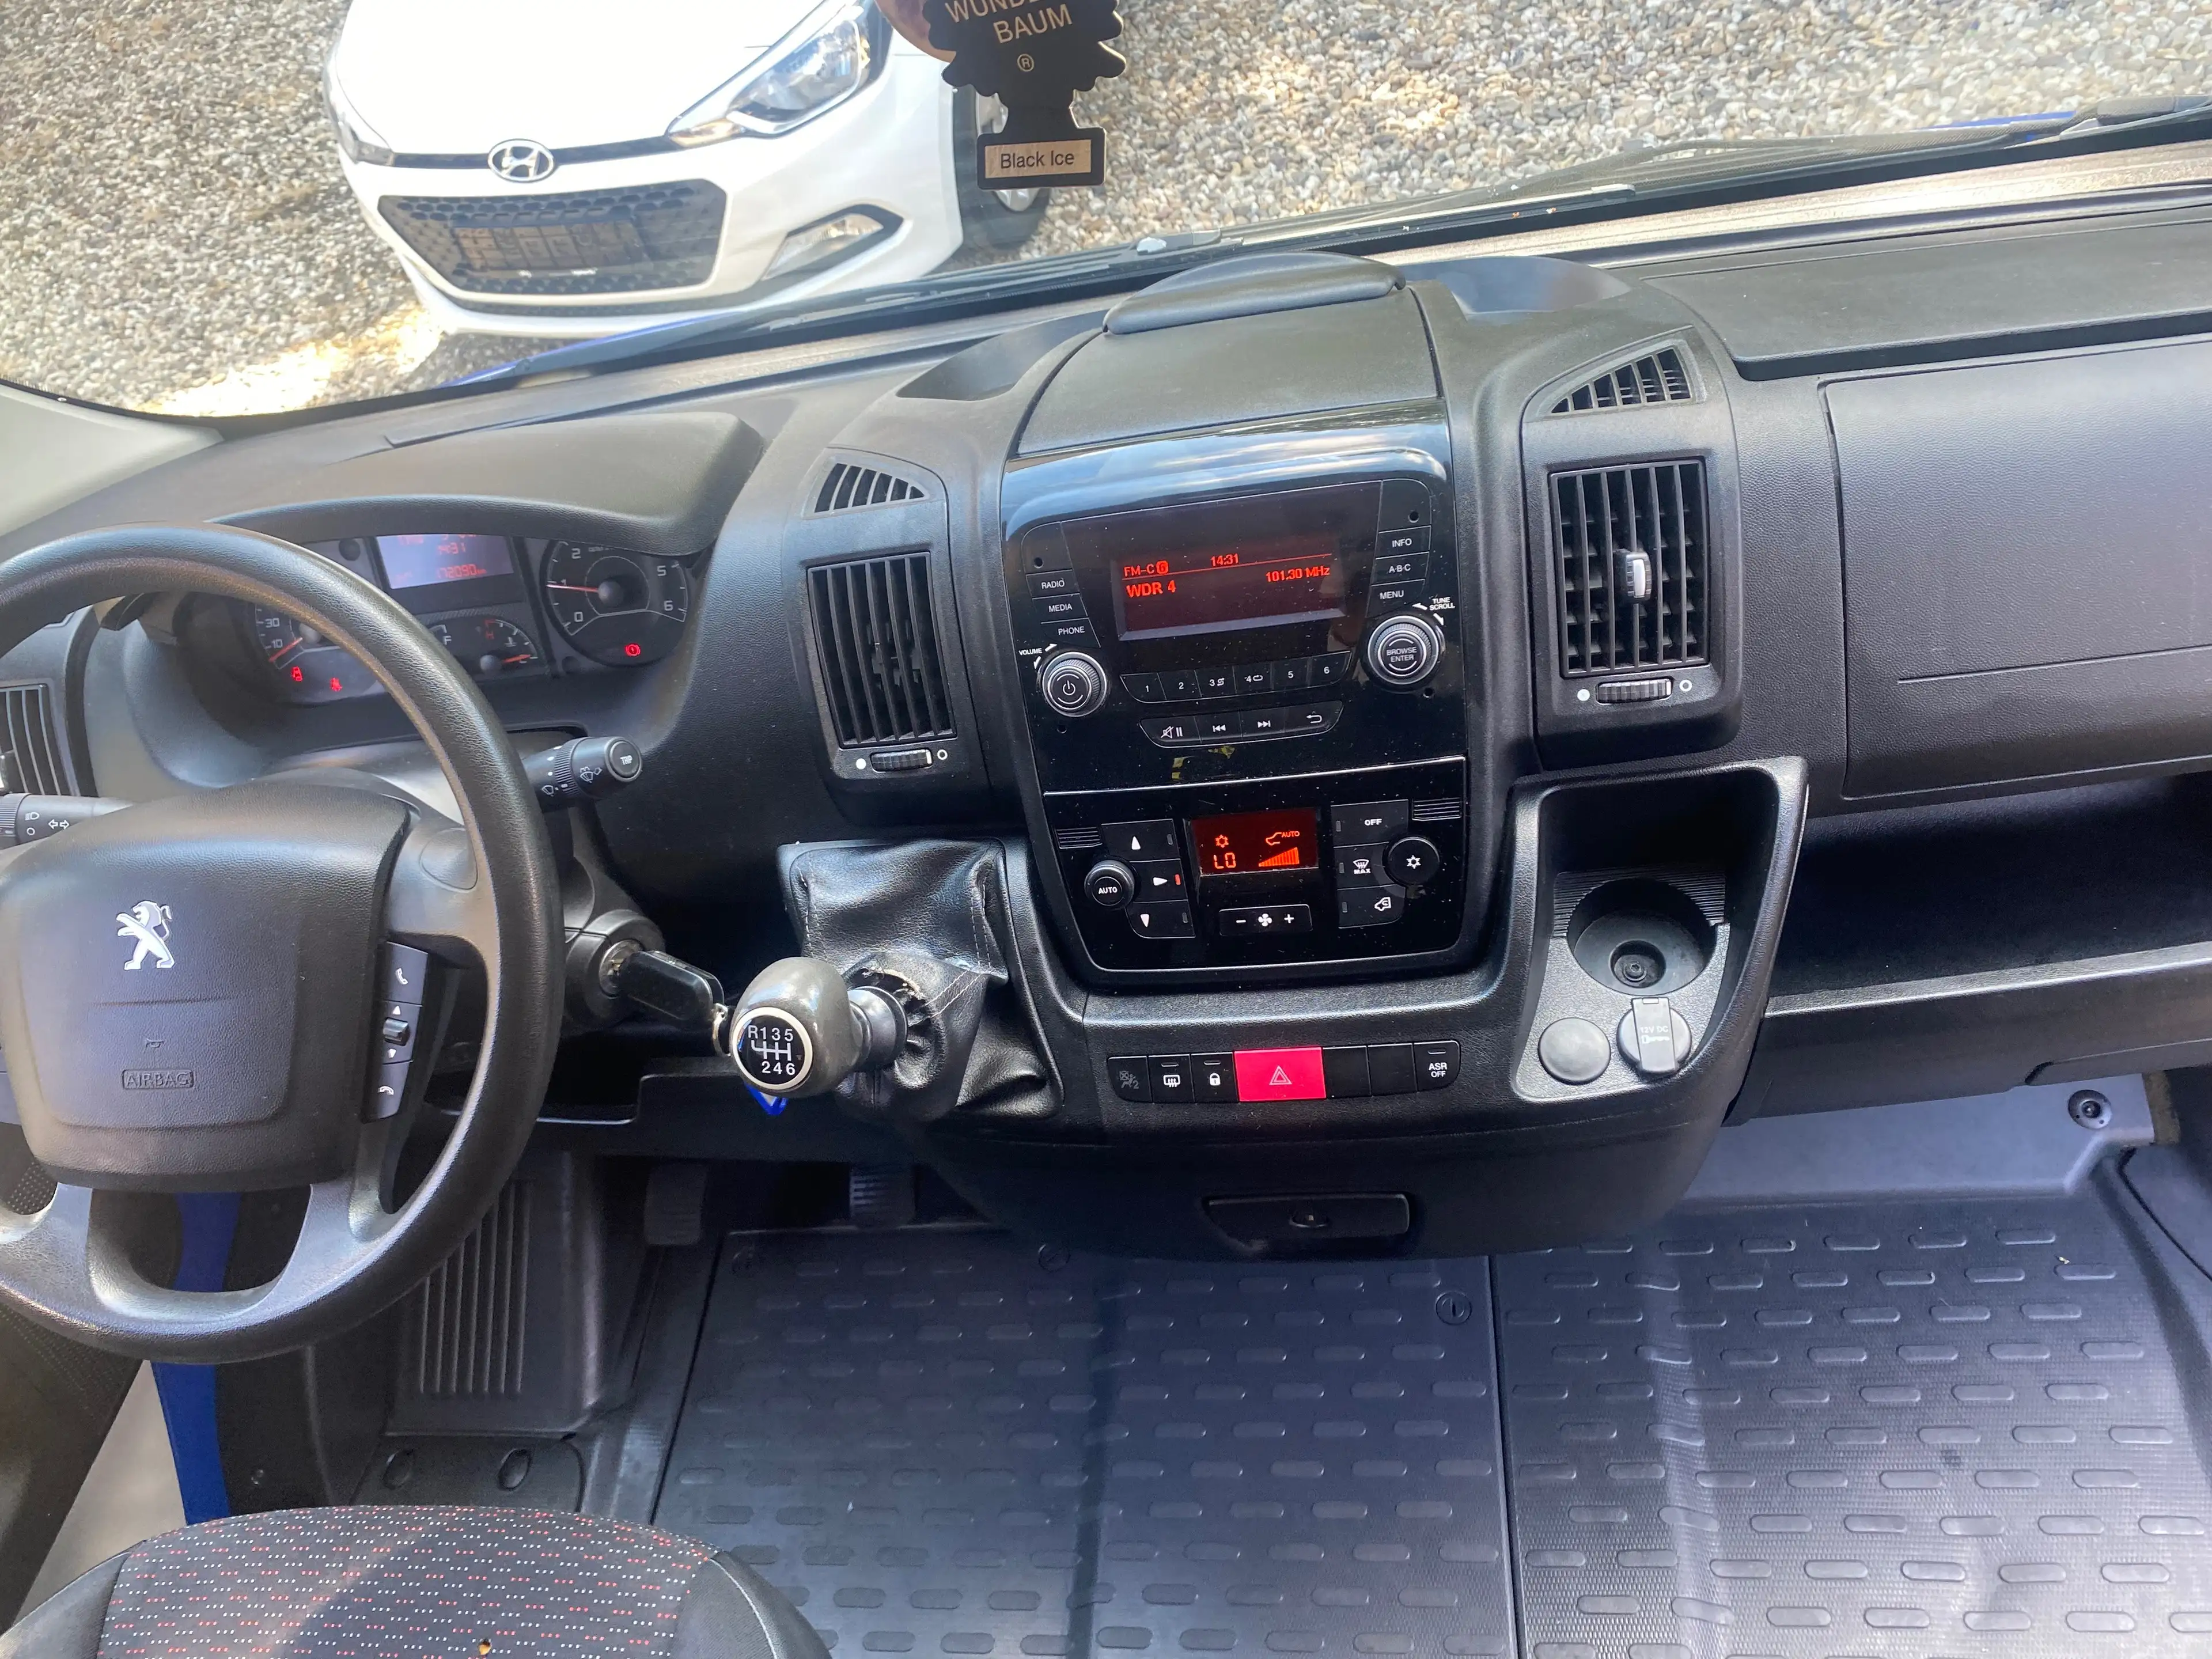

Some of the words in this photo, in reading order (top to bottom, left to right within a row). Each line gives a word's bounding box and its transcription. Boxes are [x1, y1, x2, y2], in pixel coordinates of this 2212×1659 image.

[945, 0, 1039, 22] WUN
[993, 3, 1073, 43] BAUM
[1001, 150, 1044, 169] Black
[1050, 149, 1075, 165] Ice
[1392, 538, 1412, 548] INFO
[571, 548, 581, 559] 2
[1211, 553, 1238, 567] 14:31
[657, 565, 666, 576] 5
[1124, 563, 1155, 577] FM-C
[1266, 568, 1302, 582] 101.30
[1305, 565, 1330, 578] MHz
[1041, 579, 1065, 589] RADIO
[1126, 582, 1164, 598] WDR
[1167, 579, 1176, 593] 4
[1380, 590, 1404, 600] MENU
[664, 600, 673, 611] 6
[1048, 603, 1073, 612] MEDIA
[1429, 603, 1455, 611] SCROLL
[574, 611, 583, 622] 0
[265, 618, 280, 628] 30
[1058, 626, 1085, 635] PHONE
[272, 638, 283, 648] 10
[444, 635, 452, 645] F
[1018, 648, 1043, 656] VOLUME
[1387, 647, 1417, 656] BROWSE
[1390, 654, 1415, 662] ENTER
[1287, 671, 1294, 679] 5
[1323, 666, 1331, 675] 6
[1245, 675, 1252, 683] 4
[619, 755, 632, 765] TRIP
[1364, 818, 1382, 826] OFF
[1213, 852, 1237, 869] LO
[1098, 885, 1118, 894] AUTO
[1640, 1025, 1654, 1033] 12V
[1429, 1062, 1448, 1070] ASR
[127, 1072, 189, 1087] AIRBAG
